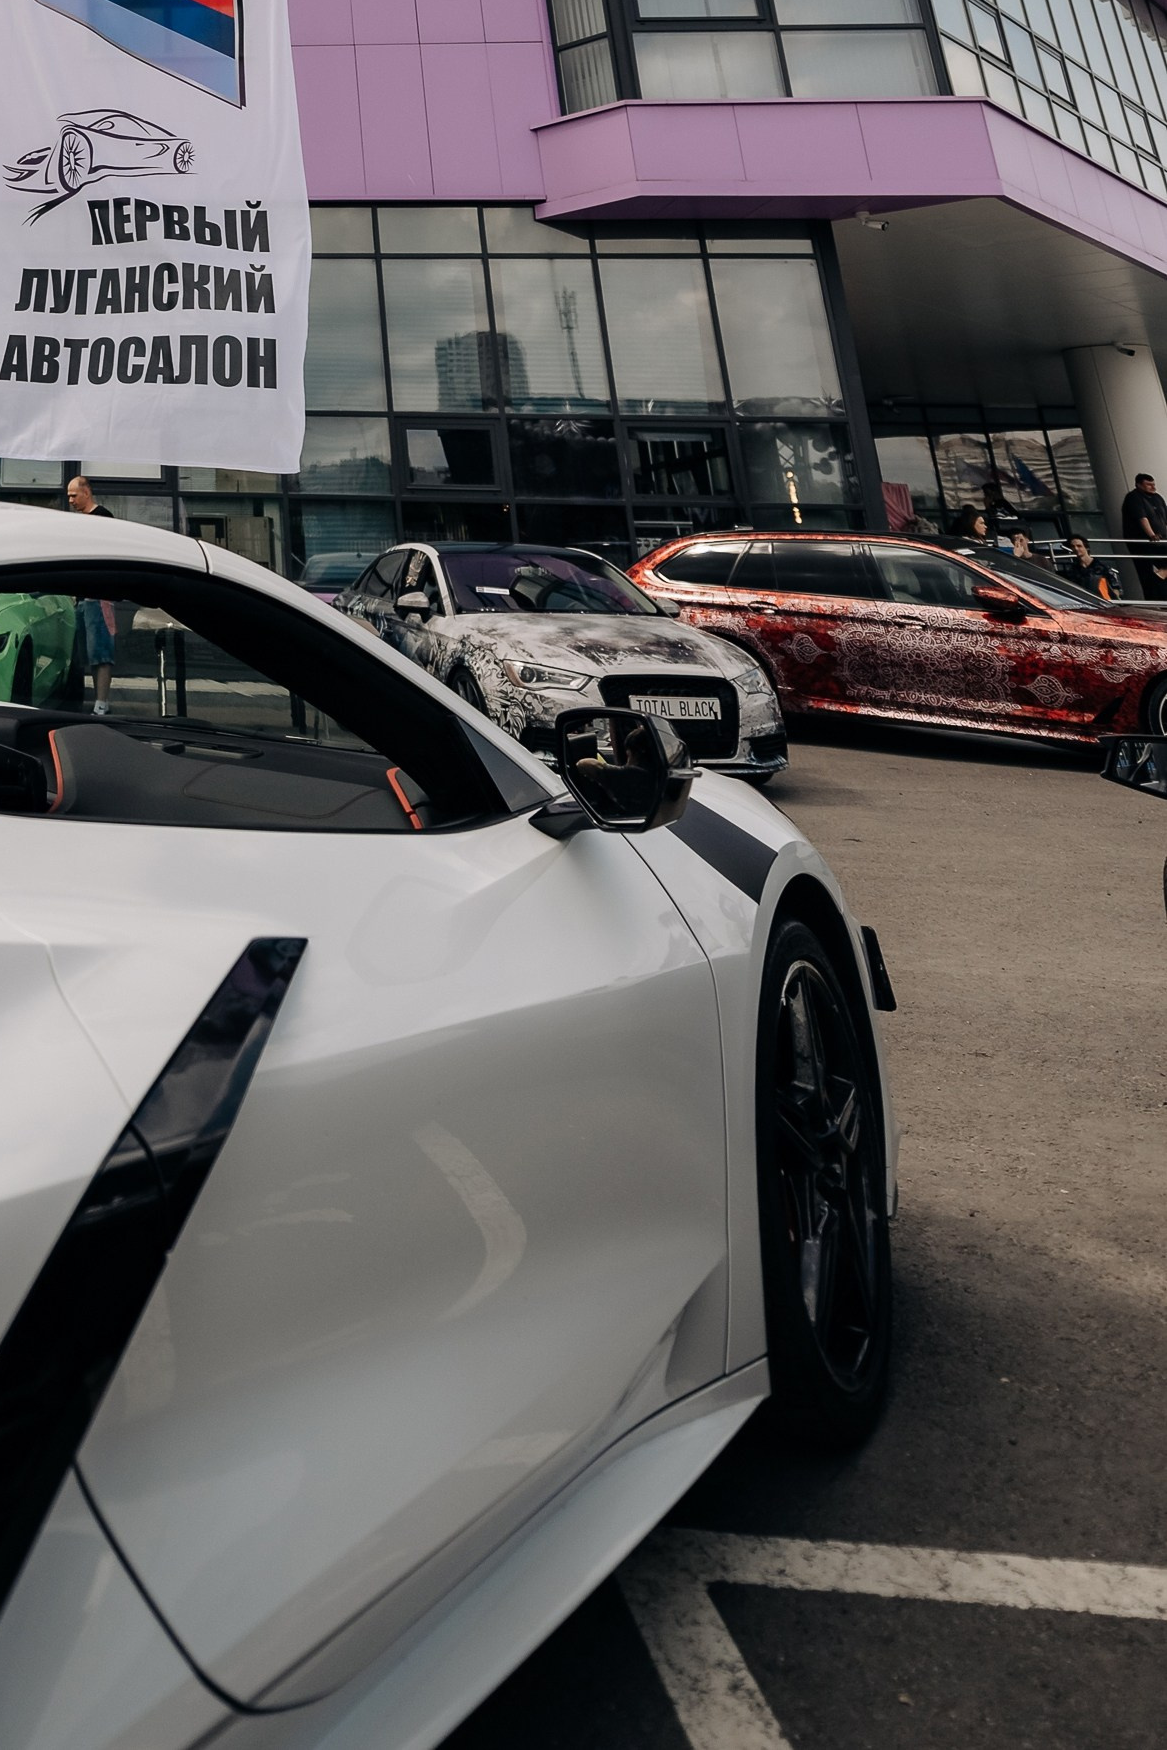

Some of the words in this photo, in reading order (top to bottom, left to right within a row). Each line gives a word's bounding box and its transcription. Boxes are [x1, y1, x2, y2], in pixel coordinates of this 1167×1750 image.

[87, 197, 270, 253] ПЕРВЫЙ
[14, 262, 276, 315] ЛУГАНСКИЙ
[636, 699, 674, 717] TOTAL
[679, 700, 716, 717] BLACK
